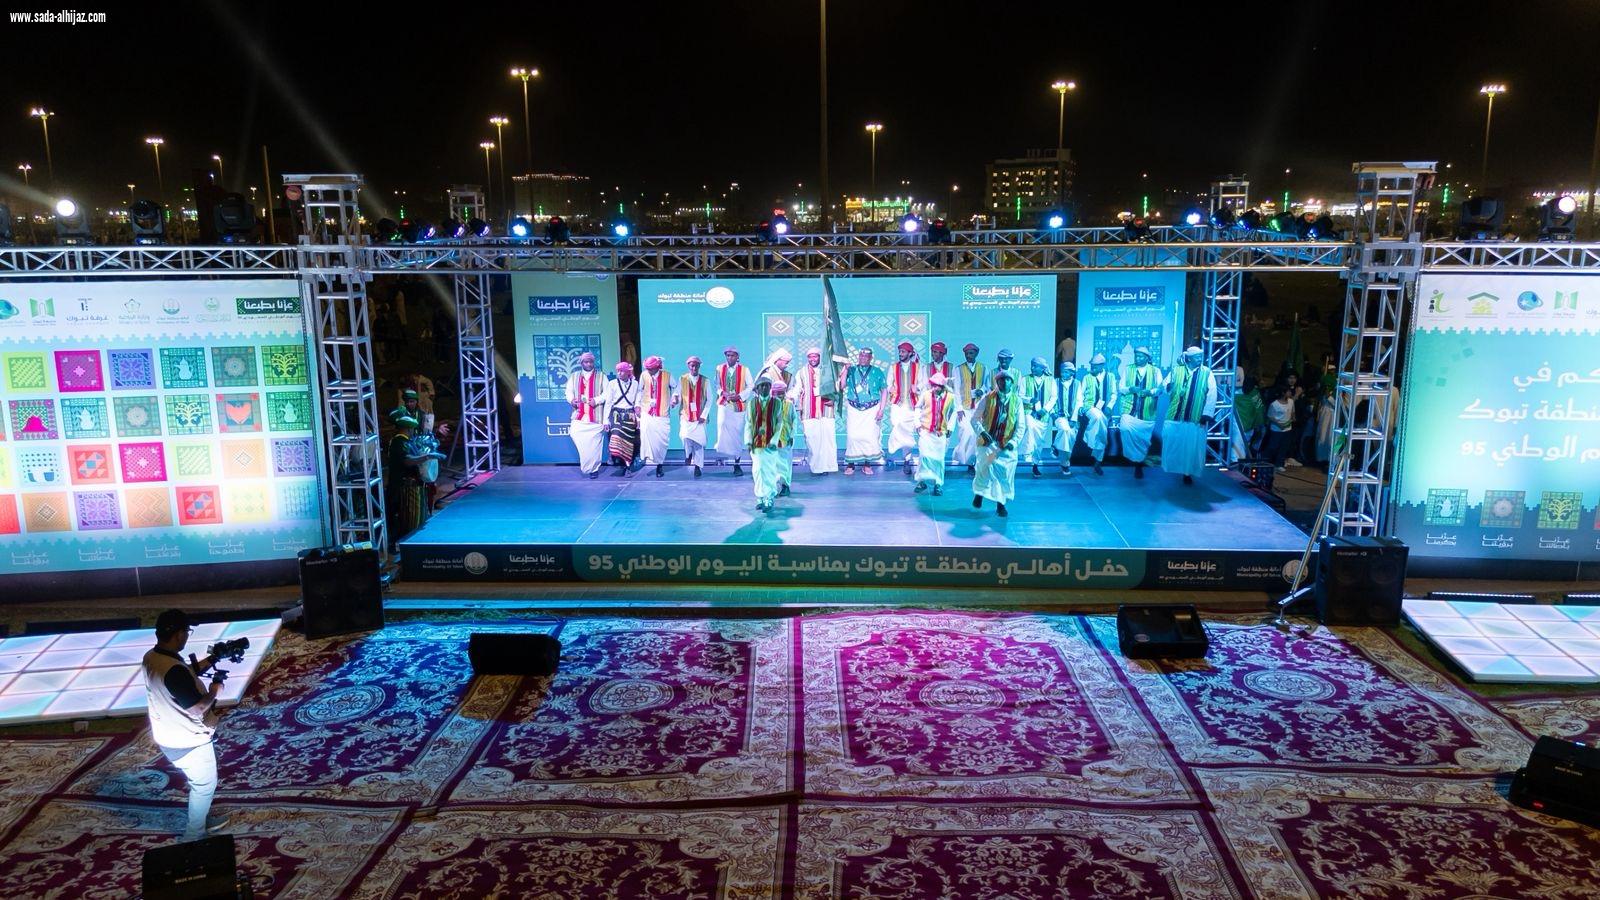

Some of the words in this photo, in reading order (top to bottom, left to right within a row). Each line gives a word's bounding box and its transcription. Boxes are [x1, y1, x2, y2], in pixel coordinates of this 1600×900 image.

[972, 286, 1009, 298] بطبعنا
[1103, 290, 1137, 303] بطبعنا
[244, 300, 275, 312] بطبعنا
[537, 299, 570, 312] بطبعنا
[1513, 361, 1552, 392] في
[1458, 398, 1529, 425] تبوك
[1461, 440, 1487, 456] 95
[1491, 434, 1578, 467] الوطني
[589, 555, 614, 570] 95
[619, 555, 691, 579] الوطني
[696, 555, 762, 576] اليوم
[768, 554, 851, 578] بمناسبة
[855, 556, 909, 578] تبوك
[915, 555, 991, 574] منطقة
[996, 553, 1070, 584] أهالي
[1075, 558, 1129, 581] حفل
